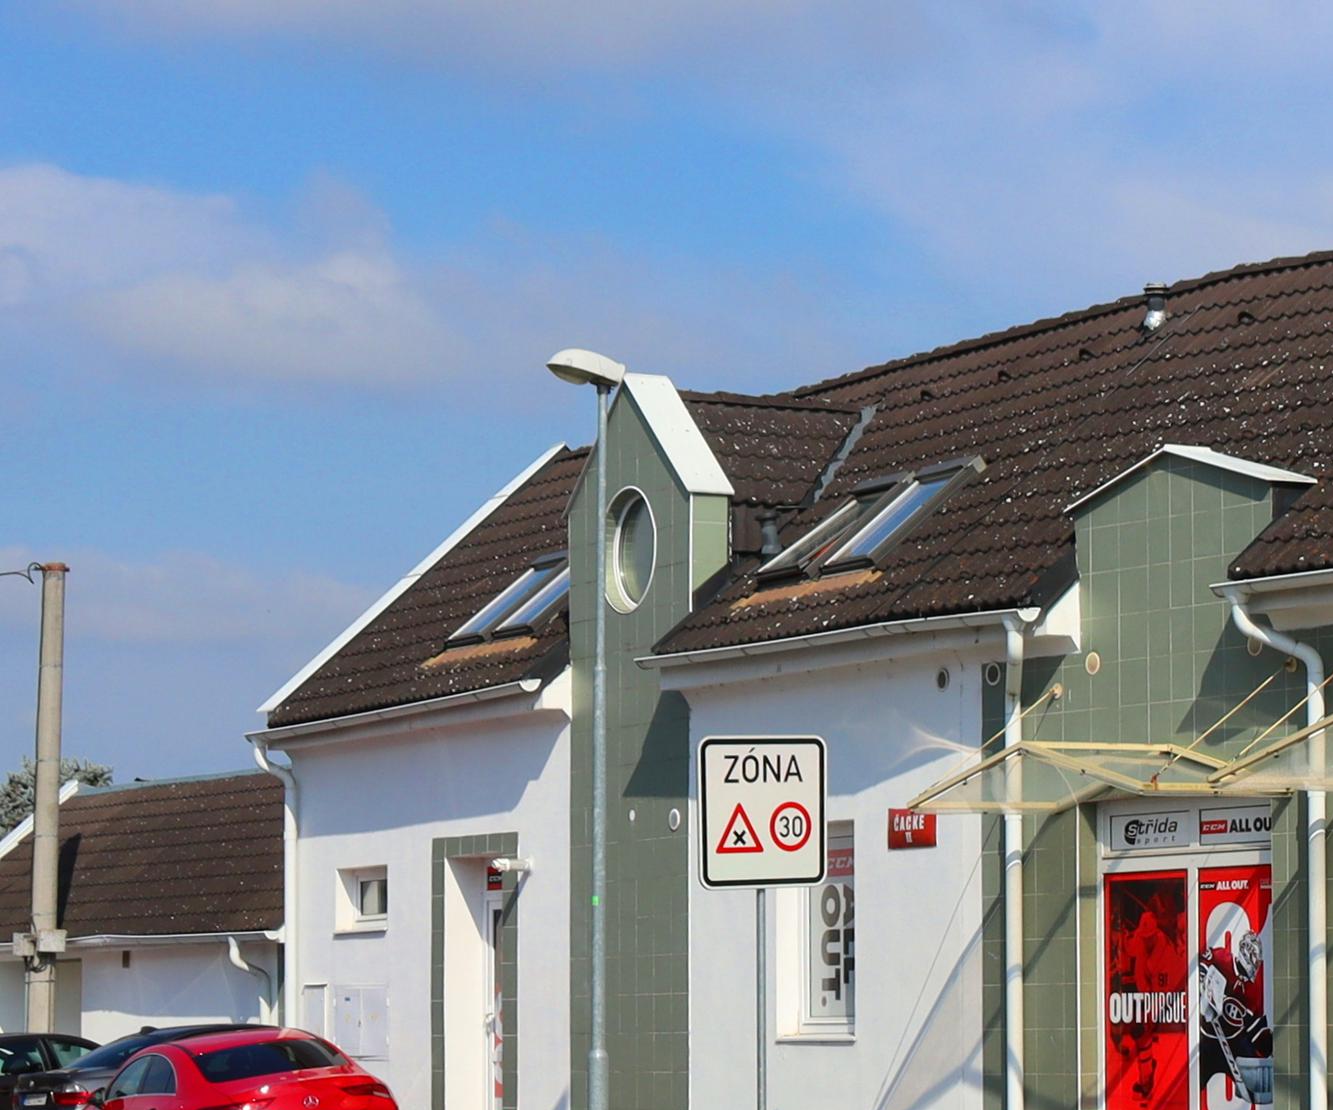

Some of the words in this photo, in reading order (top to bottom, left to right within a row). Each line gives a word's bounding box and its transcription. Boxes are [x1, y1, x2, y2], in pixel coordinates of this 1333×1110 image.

[724, 748, 803, 784] ZÓNA
[779, 816, 803, 838] 30
[1202, 822, 1226, 832] CCM
[1229, 818, 1252, 833] ALL
[1216, 881, 1231, 890] ALL
[1110, 991, 1187, 1024] OUTPURSUE
